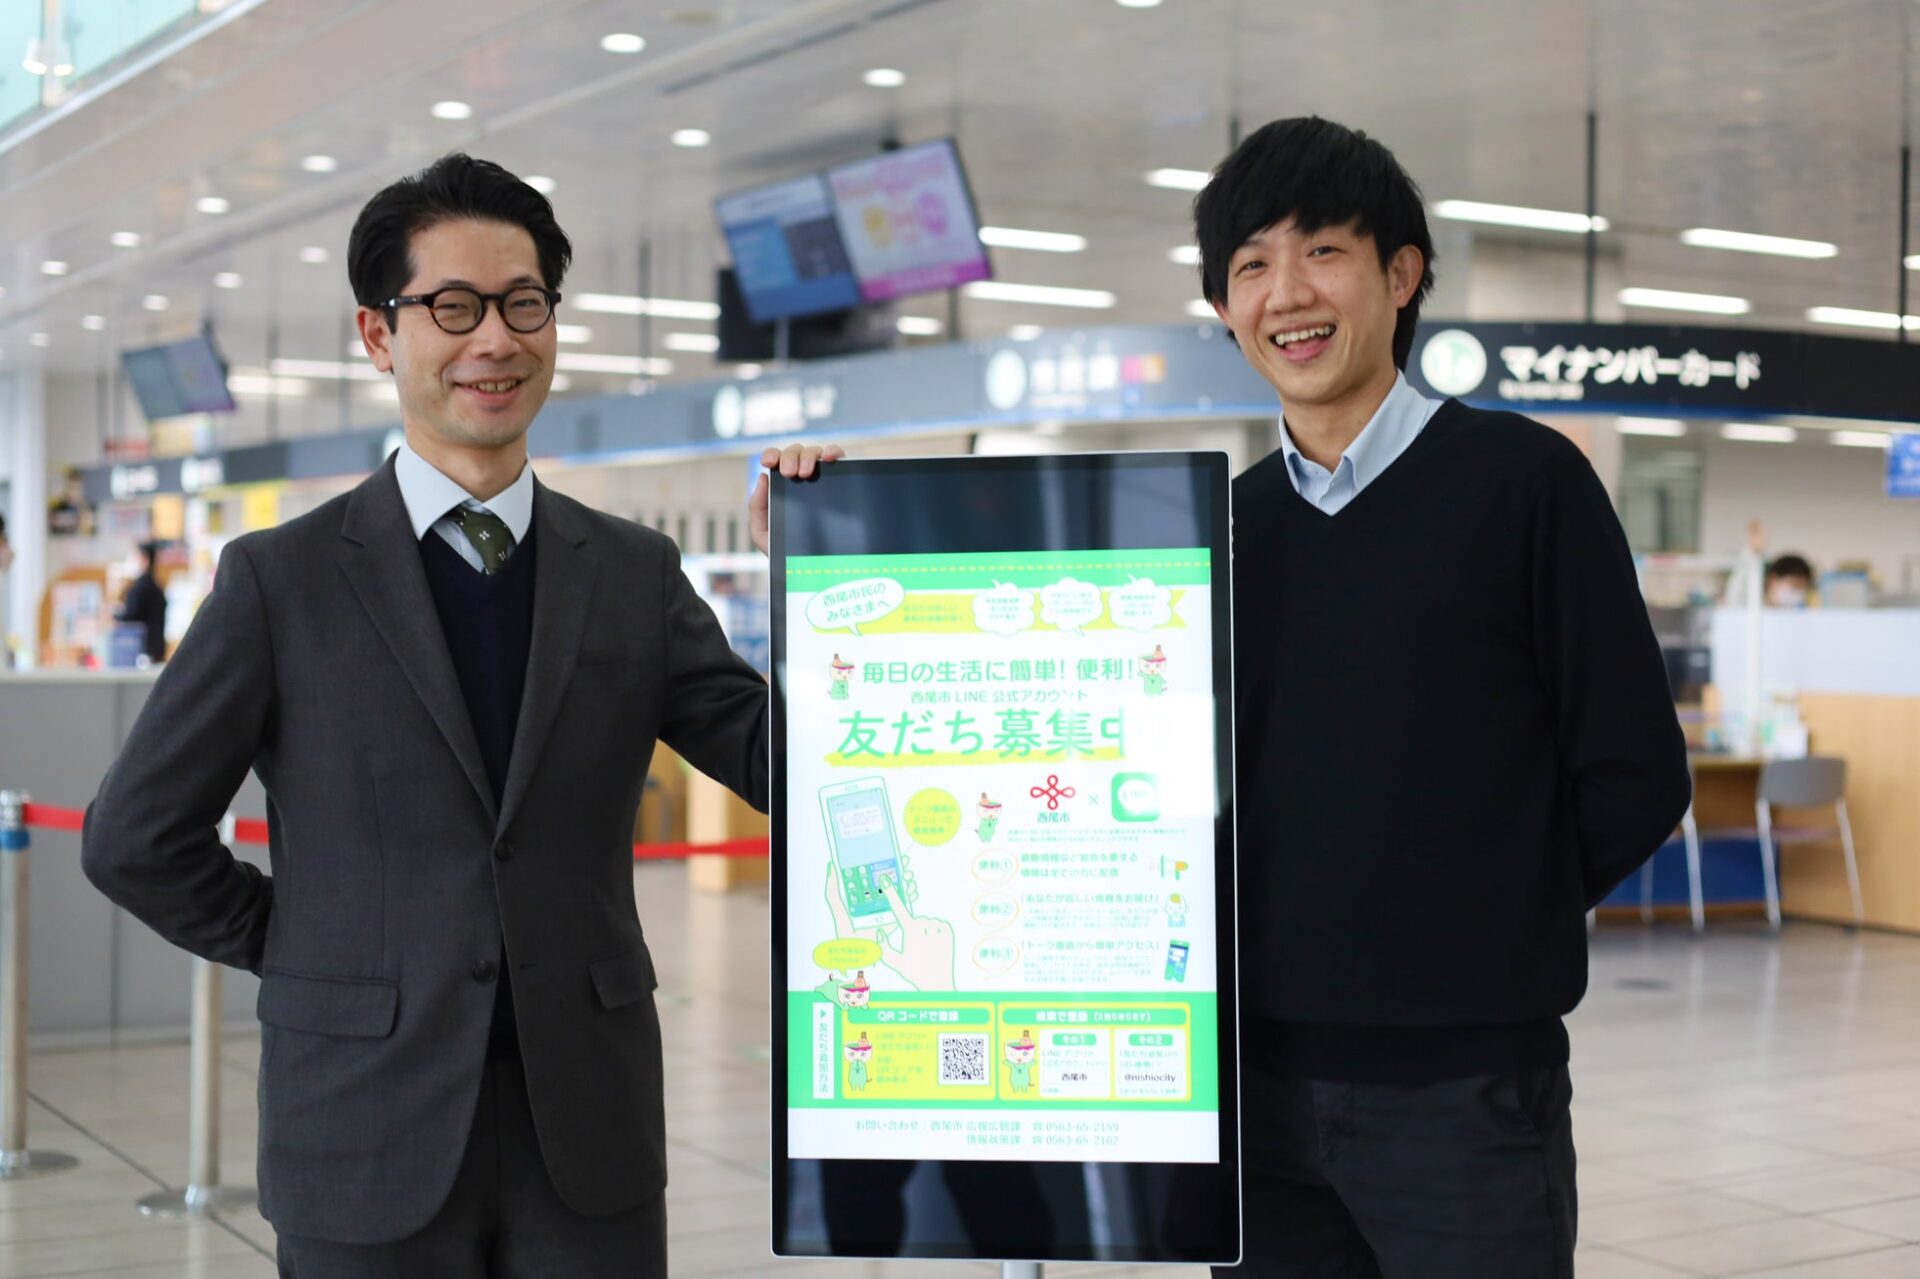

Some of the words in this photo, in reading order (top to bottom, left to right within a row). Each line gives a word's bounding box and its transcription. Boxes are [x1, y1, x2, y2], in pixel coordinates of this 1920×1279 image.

[1501, 345, 1761, 389] マイナンバーカード
[823, 583, 886, 607] 西尾市民の
[827, 600, 890, 622] みなさまへ
[911, 690, 951, 704] 西尾市
[956, 690, 988, 703] LINE
[1037, 812, 1070, 823] 西尾市
[1061, 1072, 1088, 1082] 西尾市
[1124, 1072, 1176, 1083] @nishiocity
